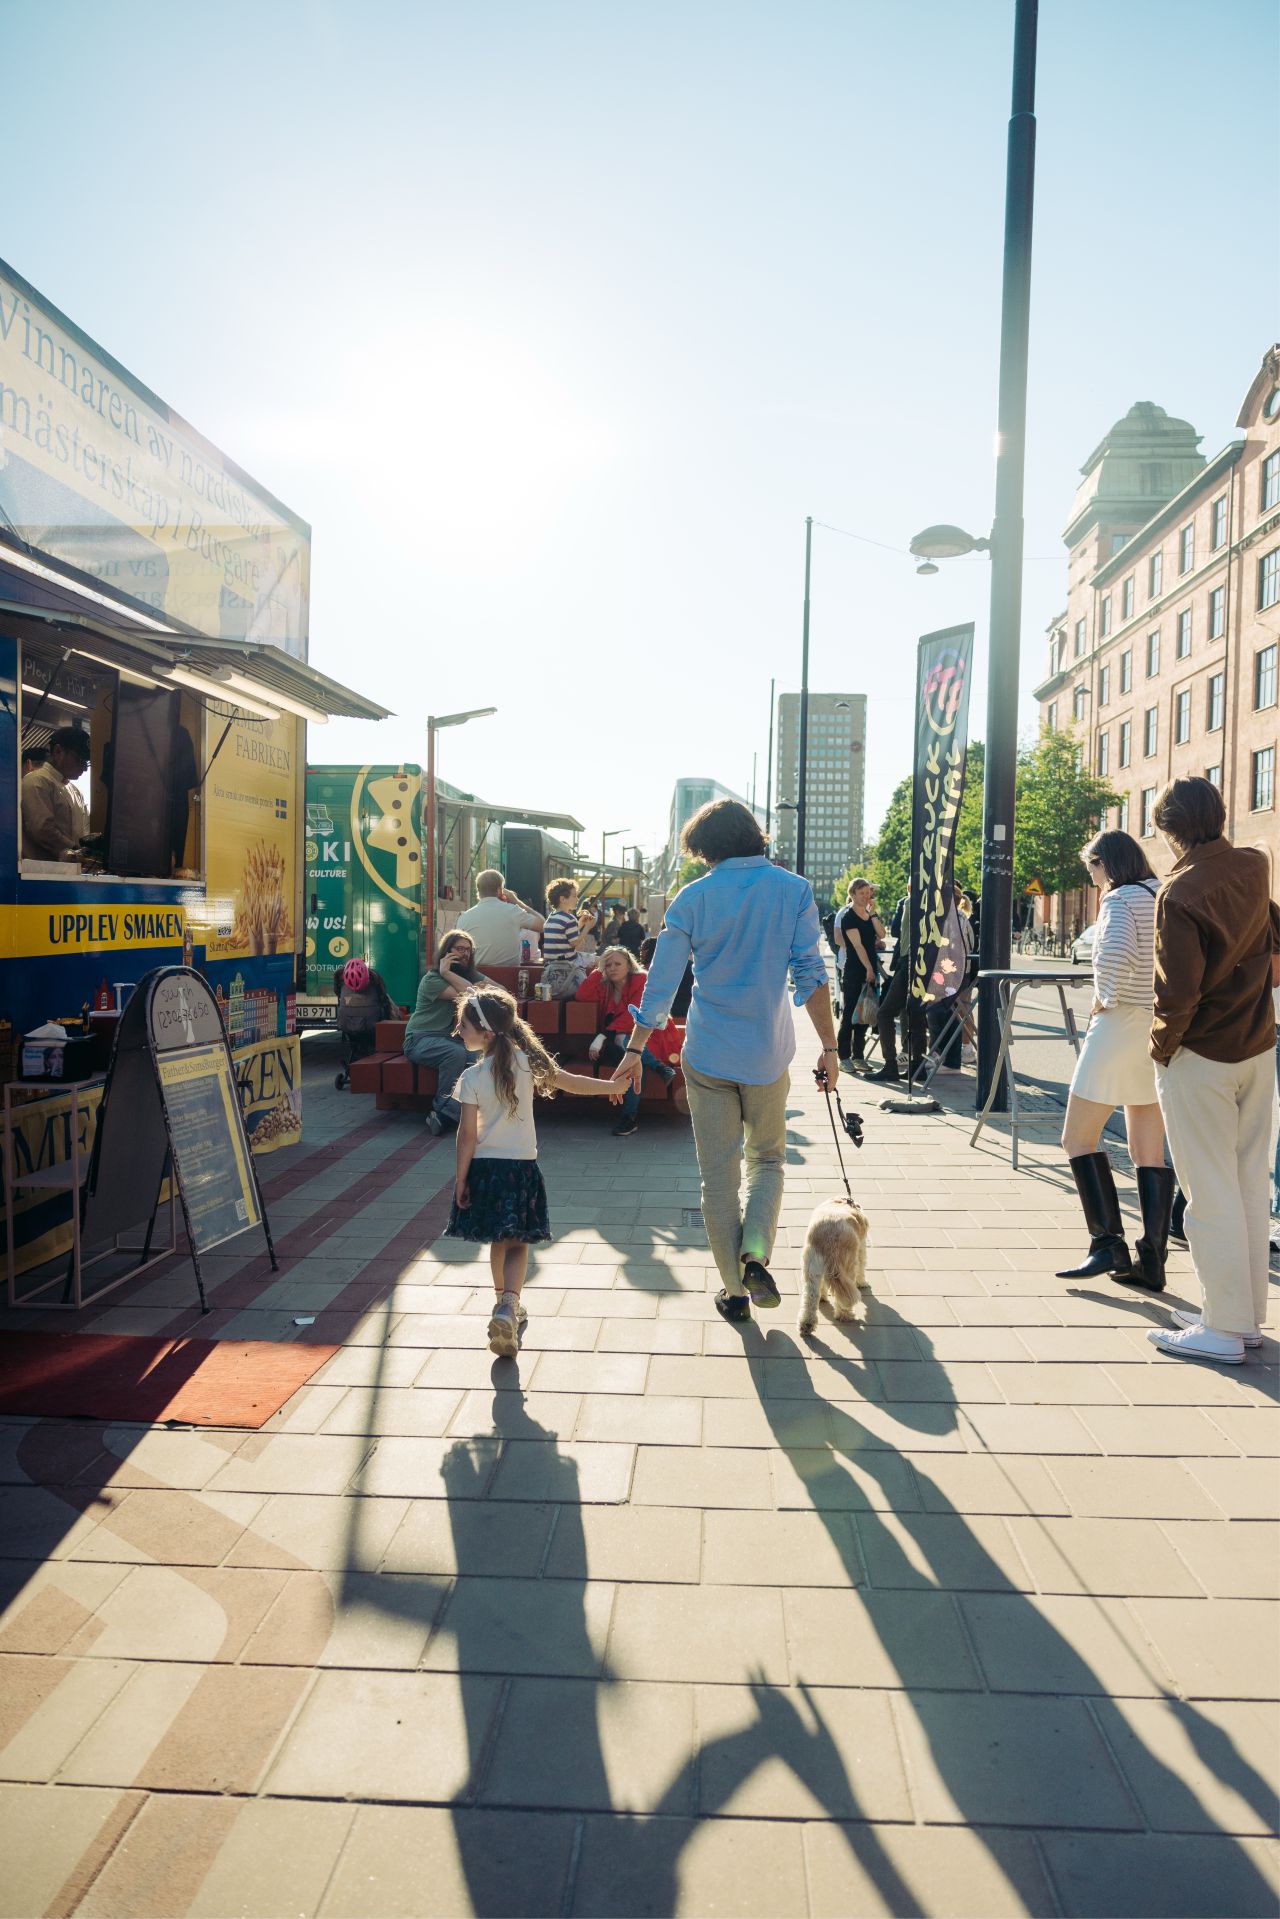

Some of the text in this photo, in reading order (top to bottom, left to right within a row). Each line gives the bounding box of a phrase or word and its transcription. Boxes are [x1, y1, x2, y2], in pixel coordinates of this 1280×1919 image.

[0, 291, 142, 446] Vinnaren
[148, 423, 174, 469] av
[0, 382, 170, 540] mästerskap
[172, 496, 184, 540] i
[24, 658, 62, 689] Ploca
[235, 735, 290, 771] FABRIKEN
[309, 869, 348, 878] CULTURE
[49, 913, 183, 944] UPPLEV SMAKEN
[323, 914, 347, 930] US!
[311, 1007, 332, 1017] 97M
[236, 1046, 295, 1107] KEN
